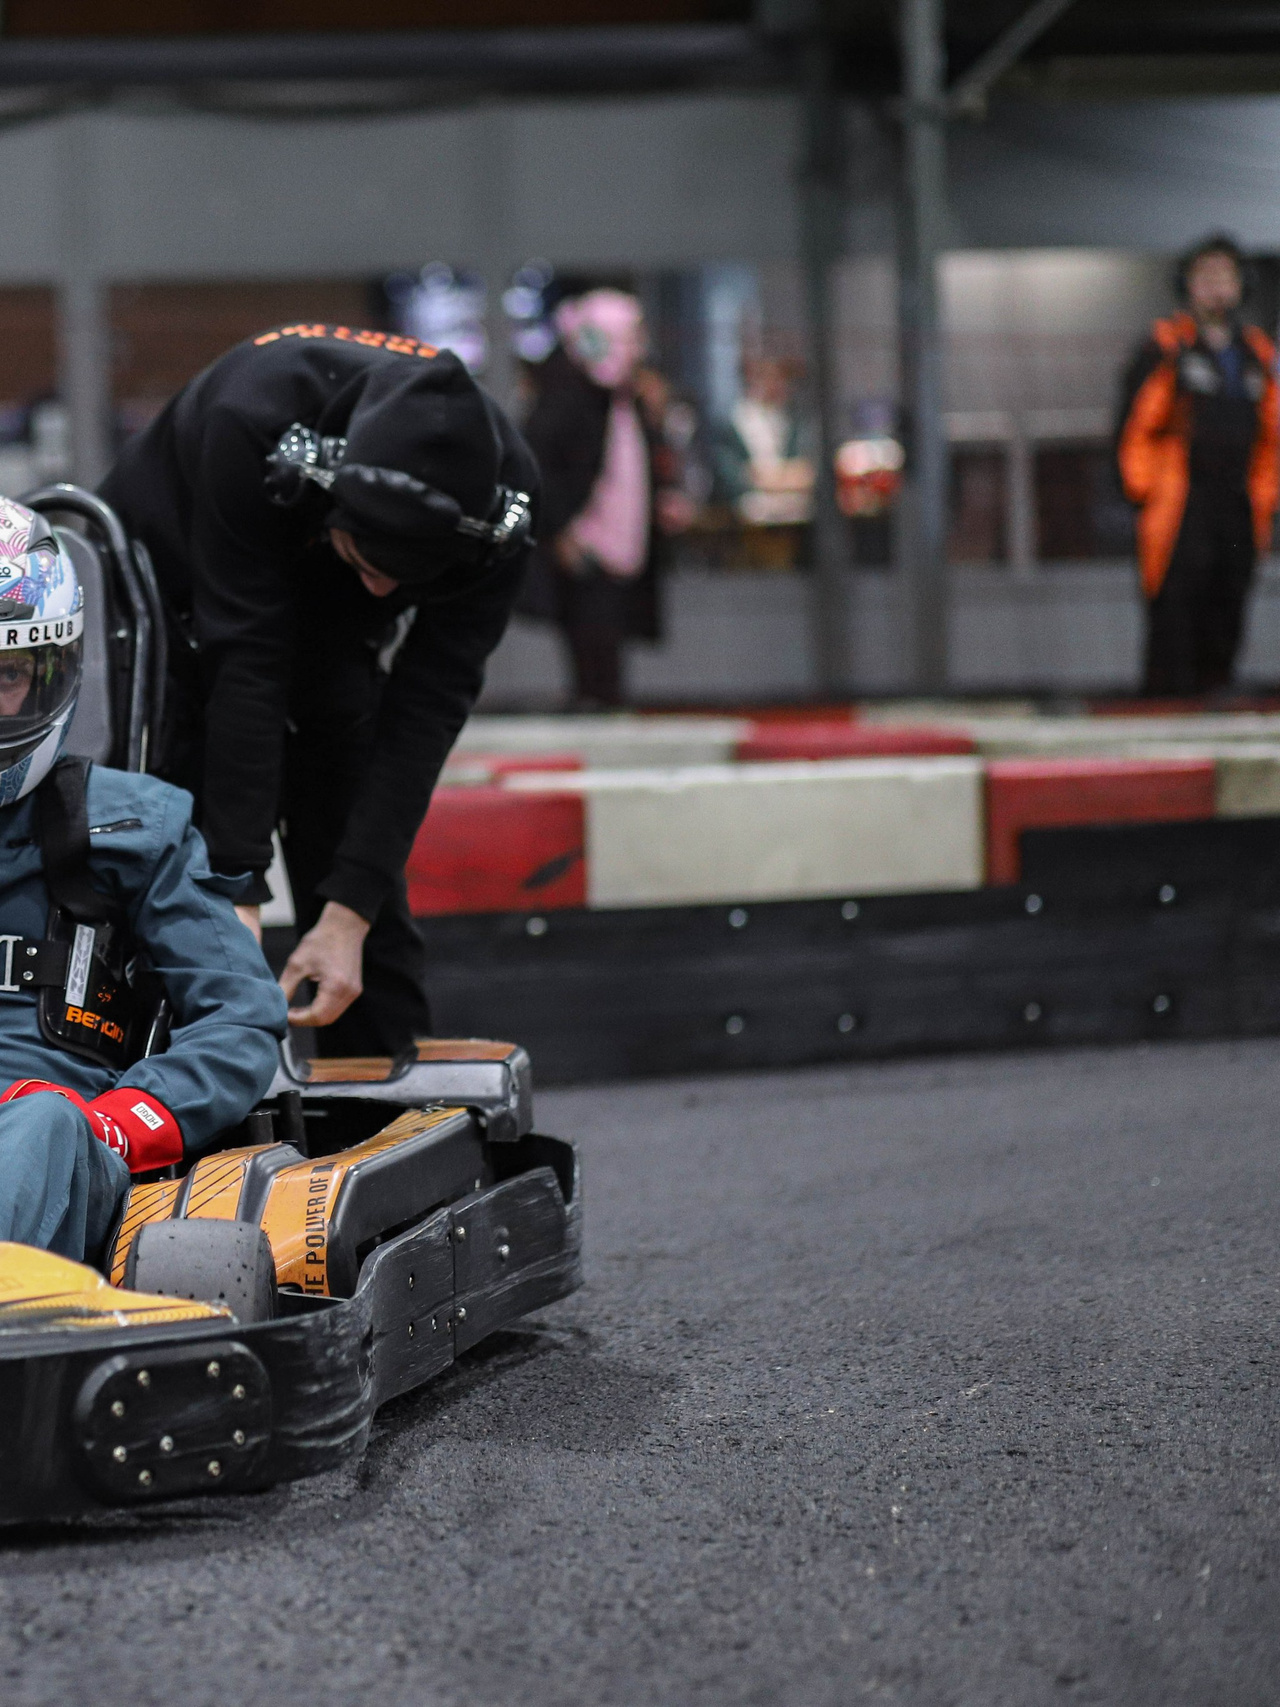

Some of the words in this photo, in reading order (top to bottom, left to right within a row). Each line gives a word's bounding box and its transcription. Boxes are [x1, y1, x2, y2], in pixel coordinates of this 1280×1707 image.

[29, 620, 74, 643] CLUB
[309, 1177, 329, 1193] OF
[305, 1196, 327, 1265] POWER
